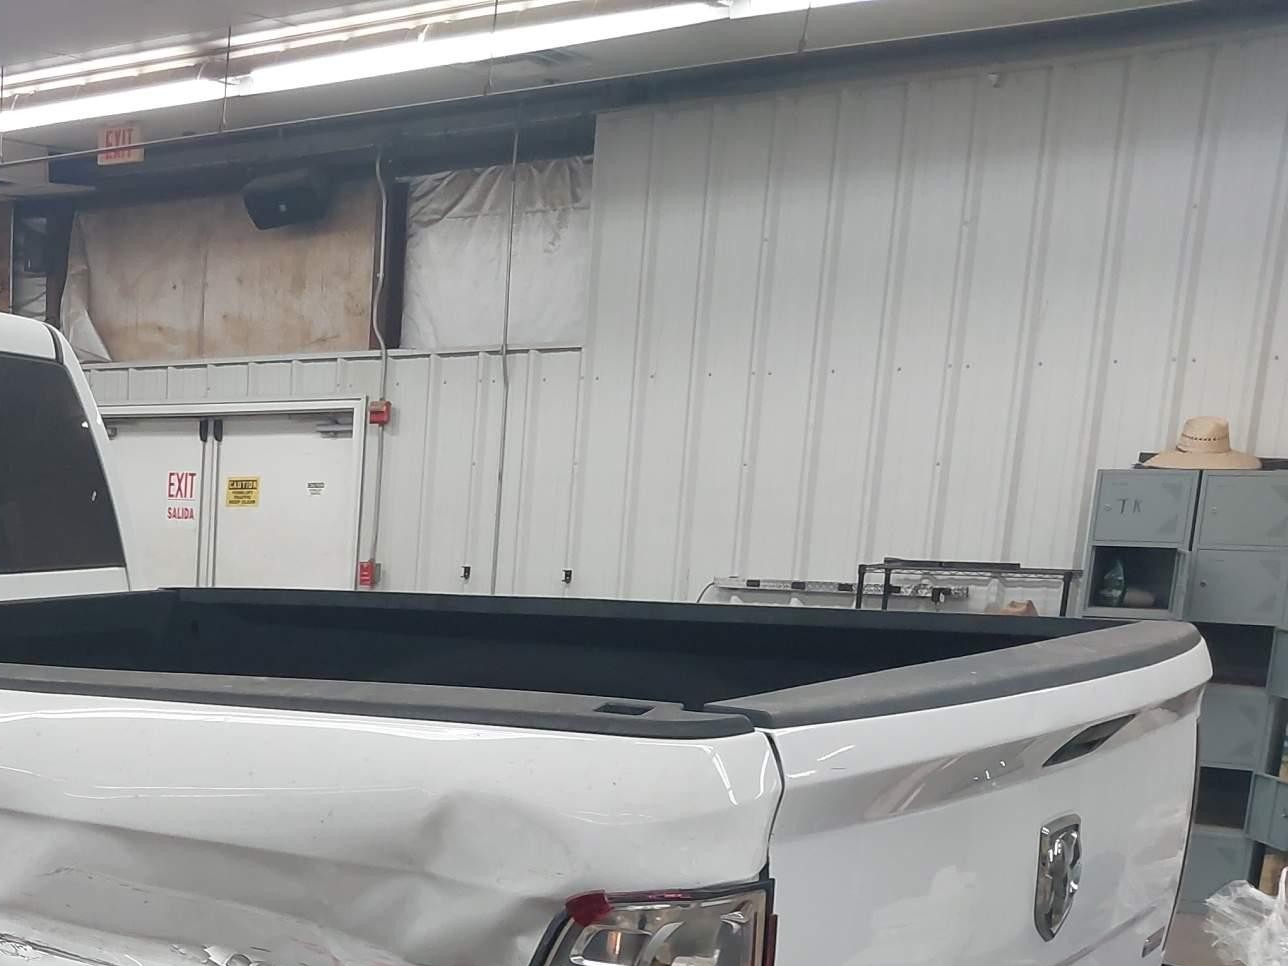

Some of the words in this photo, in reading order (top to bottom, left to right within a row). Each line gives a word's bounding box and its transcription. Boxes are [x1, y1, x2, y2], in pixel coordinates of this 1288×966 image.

[105, 128, 133, 160] EXIT
[168, 472, 196, 498] EXIT
[168, 507, 194, 519] SALIDA
